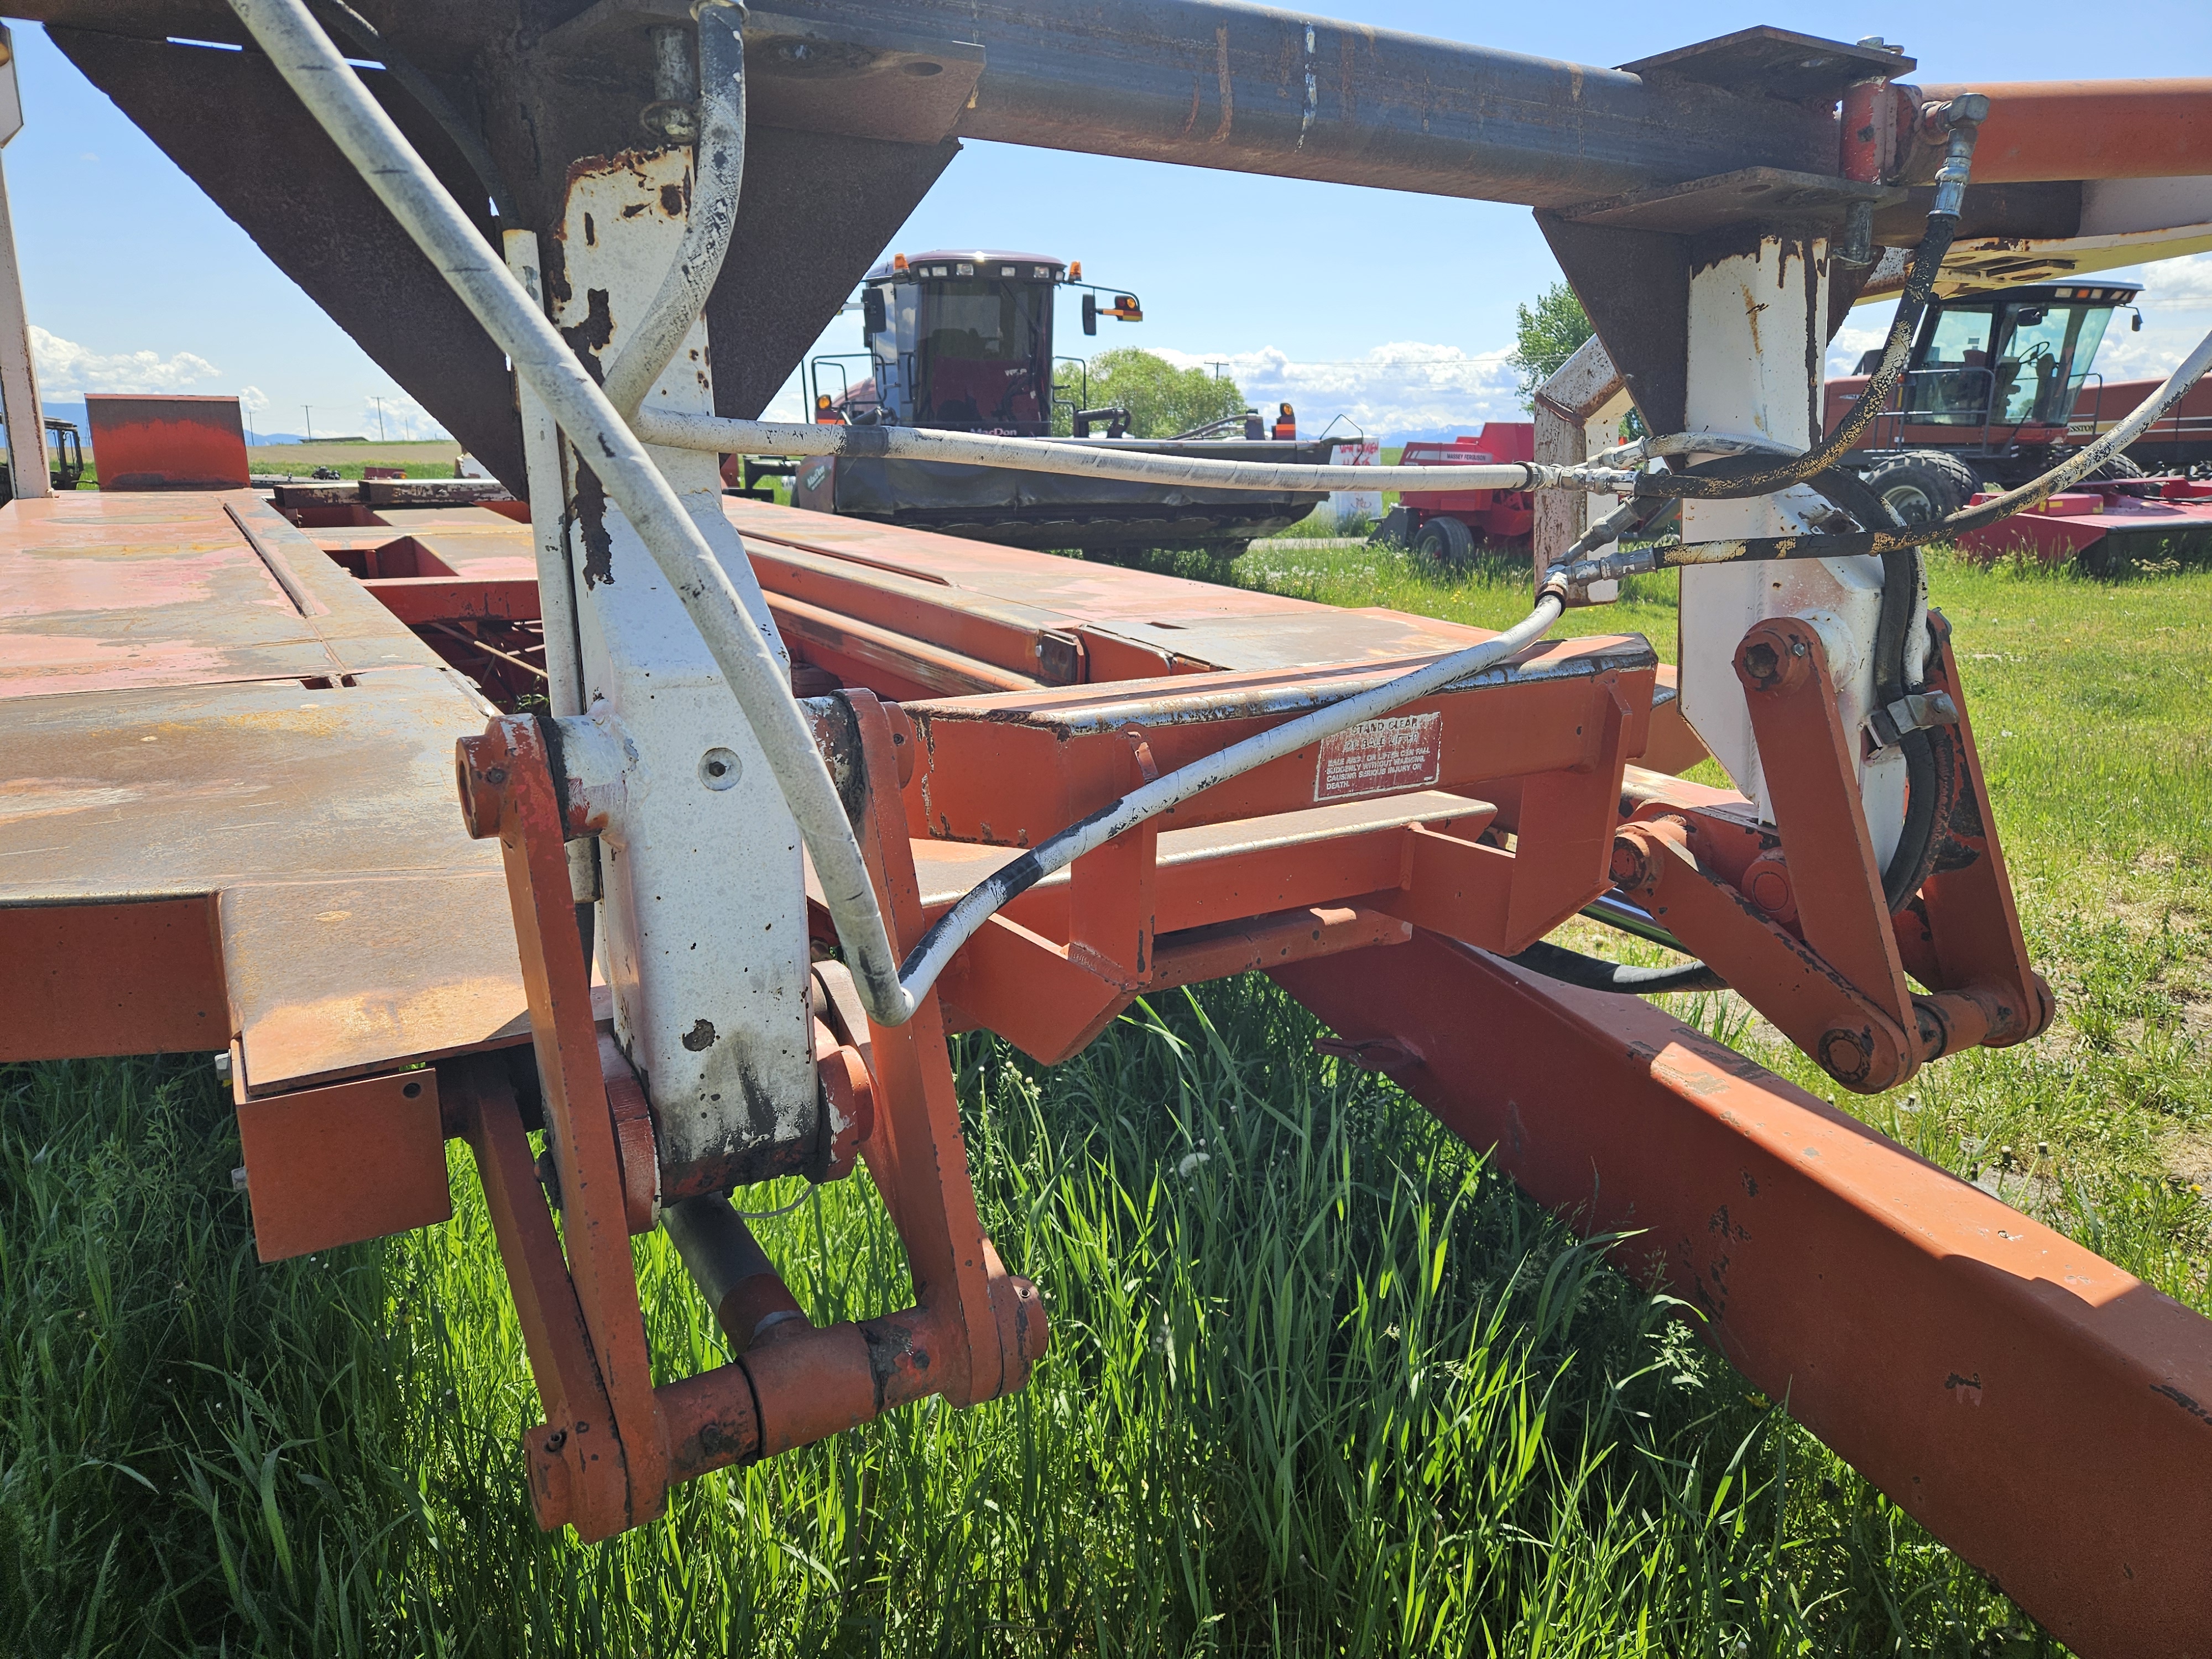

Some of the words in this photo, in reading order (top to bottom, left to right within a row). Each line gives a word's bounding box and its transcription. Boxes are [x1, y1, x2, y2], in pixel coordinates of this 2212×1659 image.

[970, 427, 1017, 436] MacDon
[1352, 722, 1385, 734] STAND
[1388, 717, 1418, 730] CLEAR
[1362, 737, 1385, 749] BALE
[1400, 749, 1415, 758] CAN
[1416, 747, 1431, 755] FALL
[1326, 763, 1361, 775] SUDDENLY
[1363, 759, 1393, 770] WITHOUT
[1394, 755, 1425, 766] WARNING.
[1327, 772, 1357, 782] CAUSING
[1358, 768, 1386, 778] SERIOUS
[1387, 764, 1411, 774] INJURY
[1412, 763, 1422, 771] OR
[1326, 780, 1350, 790] DEATH.
